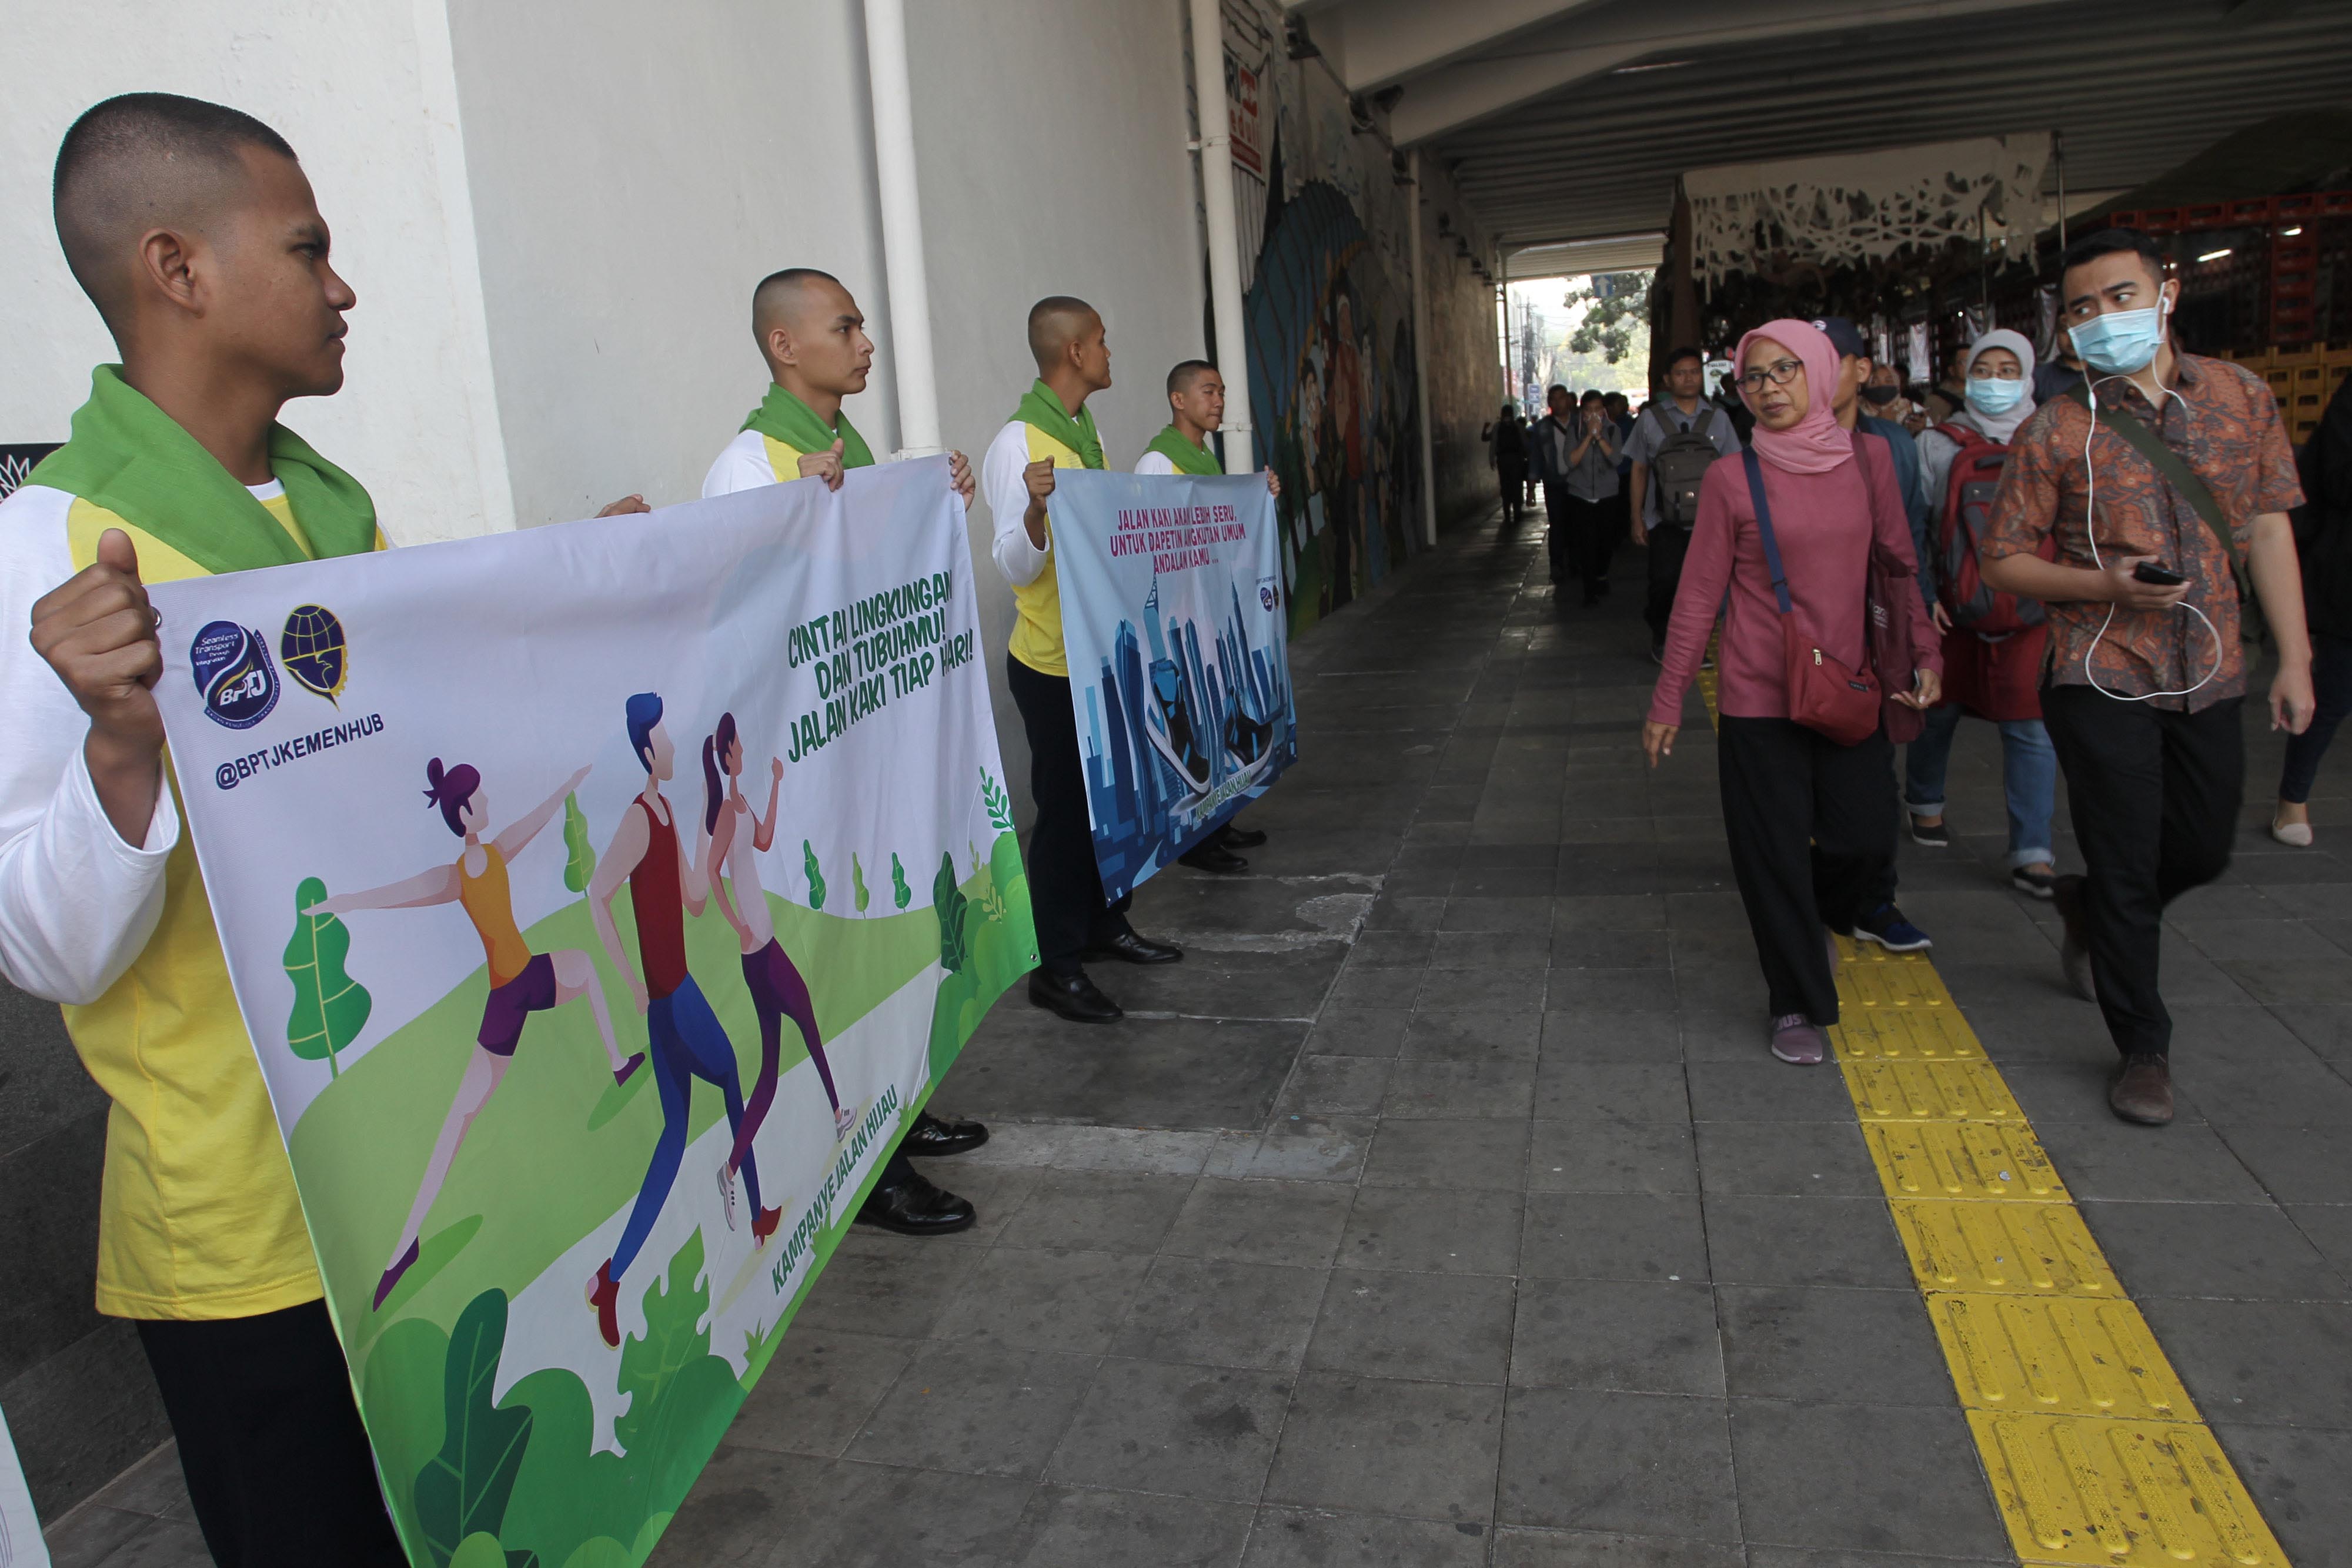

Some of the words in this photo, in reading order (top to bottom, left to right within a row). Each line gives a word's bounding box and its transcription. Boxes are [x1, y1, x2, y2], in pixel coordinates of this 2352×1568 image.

[1118, 509, 1150, 531] JALAN
[1150, 508, 1171, 528] KAKI
[1174, 507, 1190, 526] AKAN
[1190, 506, 1211, 525] LEBIH
[1212, 504, 1237, 523] SERU,
[1110, 533, 1147, 557] UNTUK
[1148, 529, 1182, 551] DAPETIN
[1184, 525, 1220, 547] ANGKUTAN
[1222, 523, 1246, 541] UMUM
[1154, 549, 1187, 574] ANDALAN
[1188, 547, 1210, 568] KAMU
[788, 609, 847, 668] CINTAI
[850, 569, 952, 639] LINGKUNGAN
[195, 641, 235, 654] Transport
[202, 633, 239, 646] Seamless
[814, 649, 852, 700] DAN
[853, 607, 946, 677] TUBUHMU!
[219, 669, 266, 706] BPTJ
[788, 695, 847, 763] JALAN
[848, 673, 887, 725] KAKI
[888, 651, 934, 698] TIAP
[940, 628, 973, 677] HARI!
[215, 713, 384, 790] @BPTJKEMENHUB
[771, 1173, 836, 1296] KAMPANYE
[836, 1129, 868, 1192] JALAN
[867, 1084, 898, 1141] HIJAU
